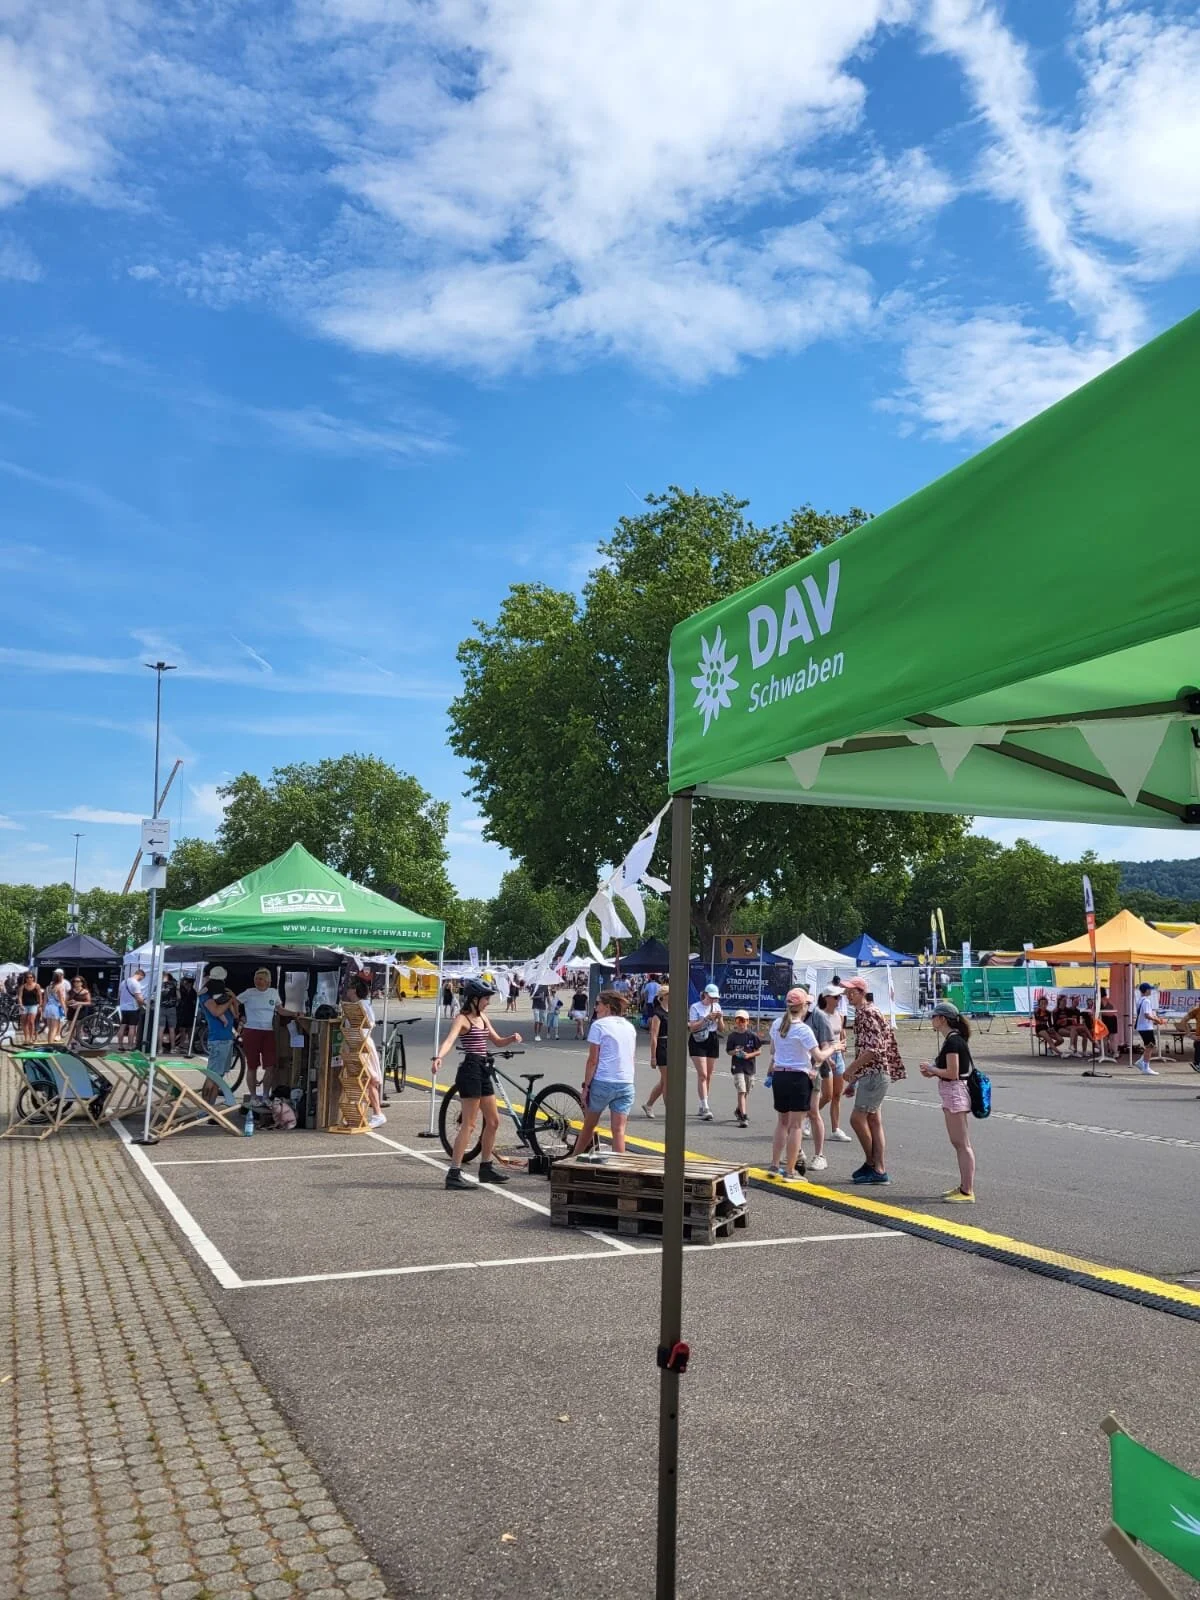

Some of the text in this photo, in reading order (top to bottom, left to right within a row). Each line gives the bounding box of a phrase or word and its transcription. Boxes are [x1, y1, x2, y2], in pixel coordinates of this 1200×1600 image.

[748, 558, 841, 671] DAV
[748, 651, 845, 713] Schwaben
[287, 892, 336, 905] DAV
[282, 924, 432, 939] WWW.ALPENVEREIN-SCHWABEN.DE
[734, 968, 745, 976] 12.
